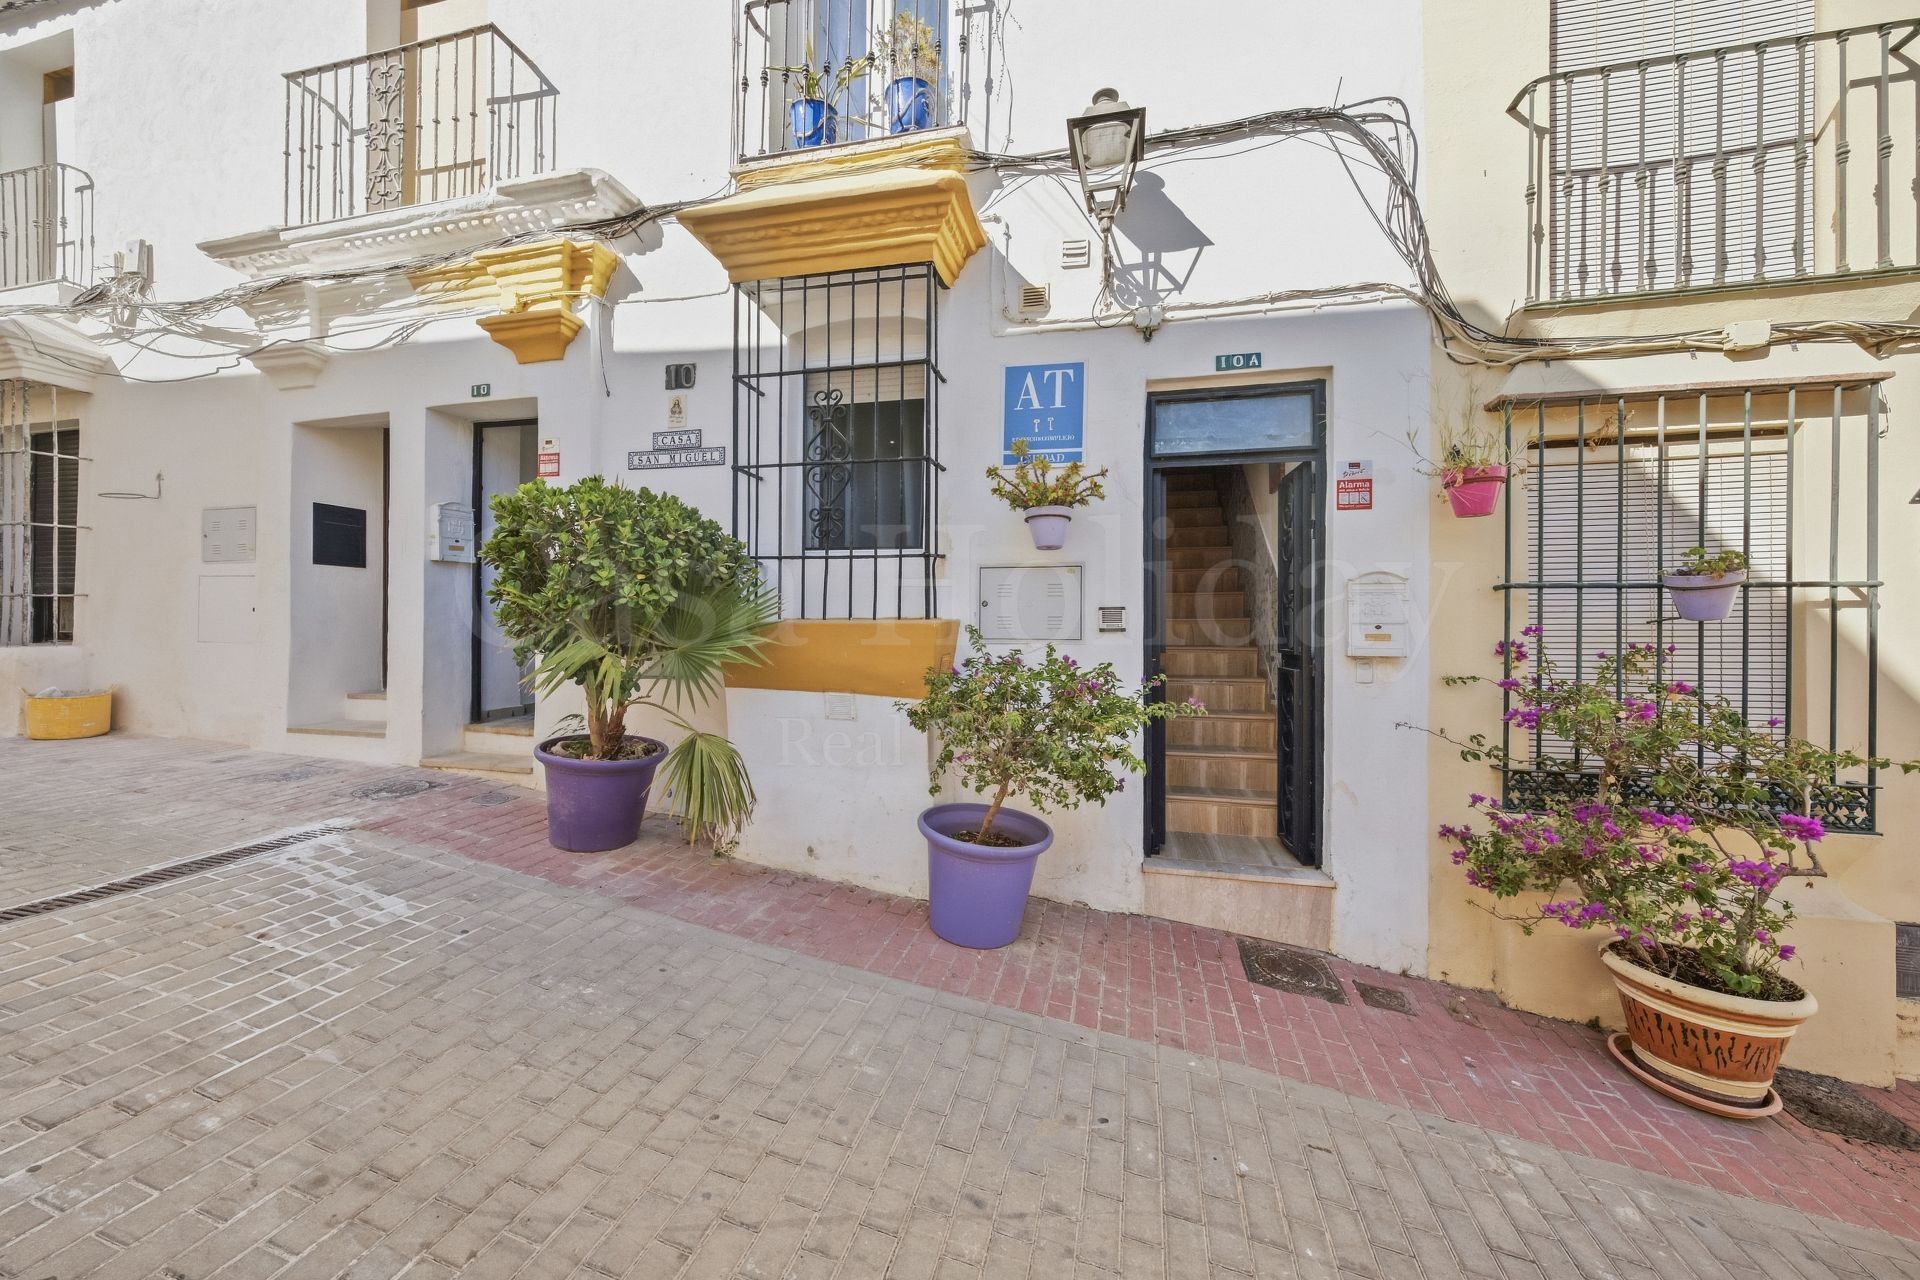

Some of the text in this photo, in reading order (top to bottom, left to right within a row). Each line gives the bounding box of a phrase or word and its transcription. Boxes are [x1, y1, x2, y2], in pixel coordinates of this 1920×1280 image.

[1220, 354, 1260, 368] 10A
[669, 364, 696, 389] 10
[473, 385, 488, 396] 10
[1014, 368, 1075, 411] AT
[661, 435, 692, 445] CASA
[637, 452, 716, 465] SAN MIGUEL
[1339, 481, 1370, 489] Alarma
